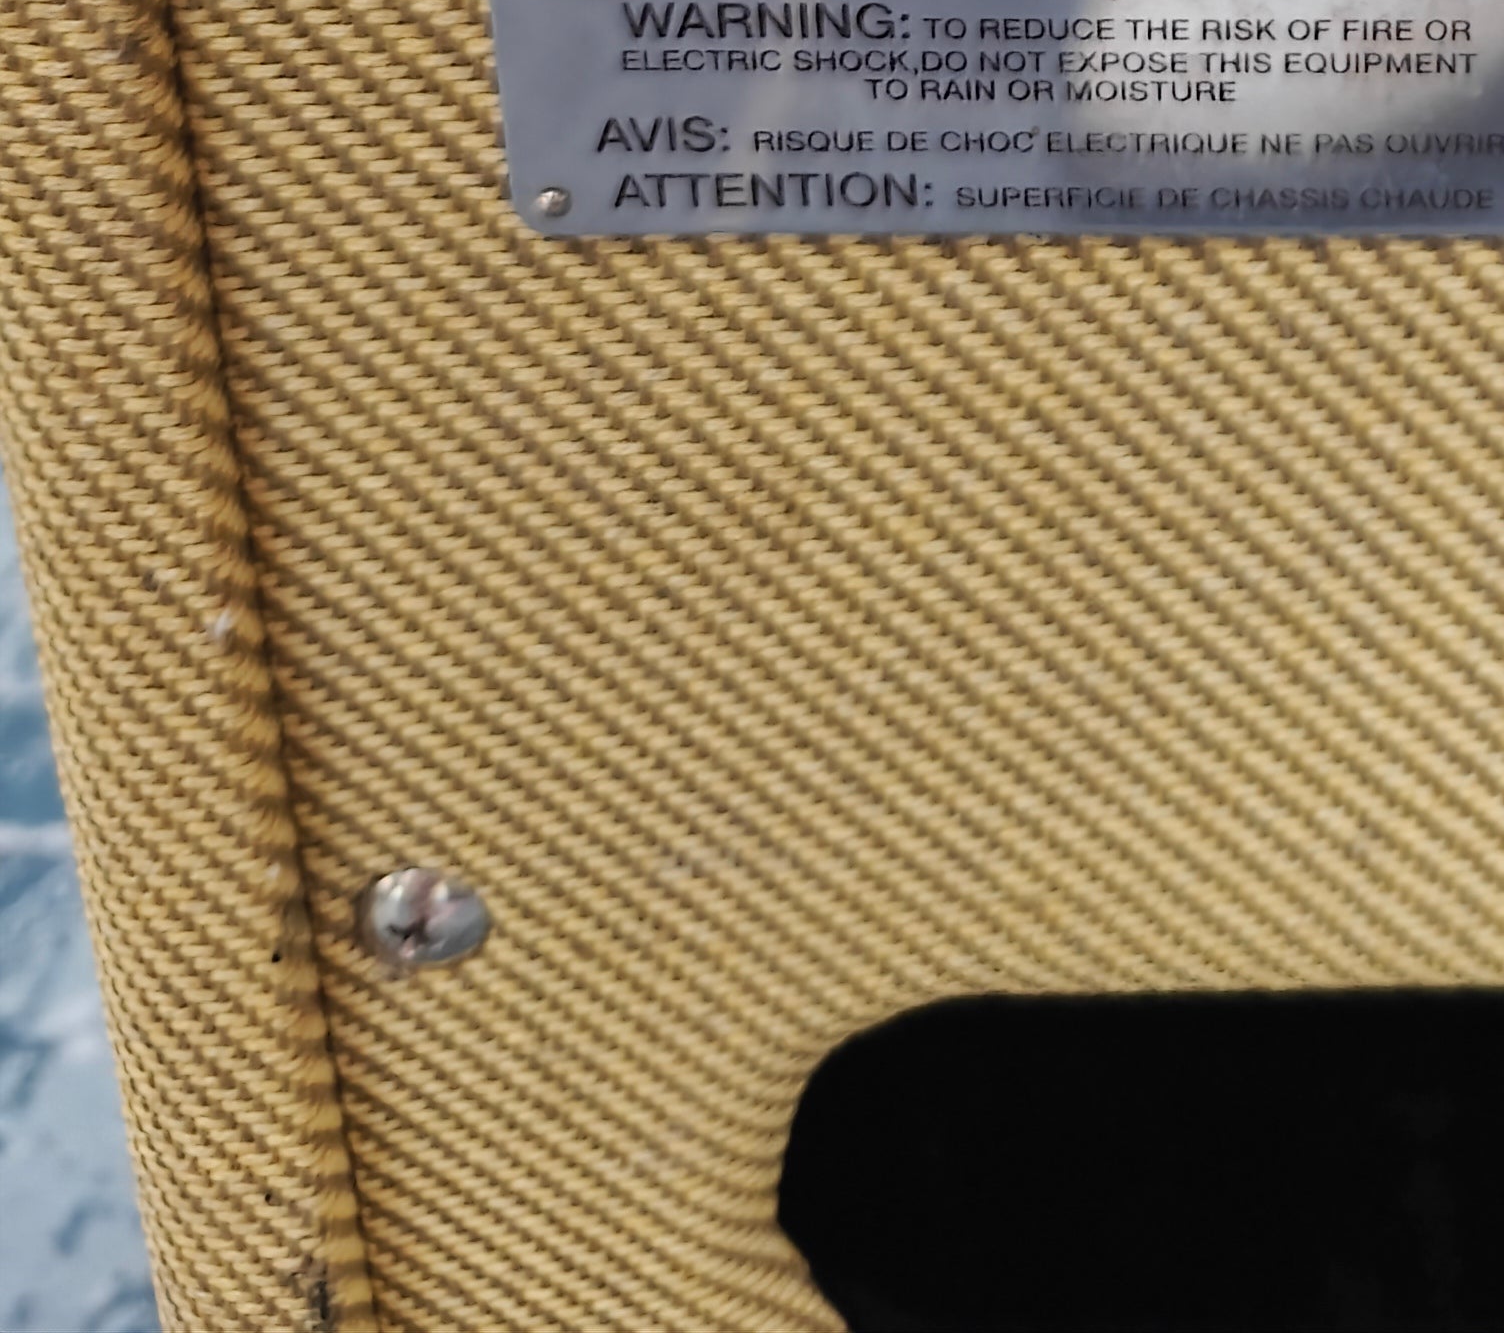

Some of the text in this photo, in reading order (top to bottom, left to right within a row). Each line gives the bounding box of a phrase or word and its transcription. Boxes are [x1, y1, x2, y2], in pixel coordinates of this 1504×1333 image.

[622, 2, 1471, 42] WARNING: TO REDUCE THE RISK OF FIRE OR
[622, 49, 782, 72] ELECTRIC
[979, 50, 1046, 73] NOT
[1059, 51, 1189, 74] EXPOSE
[1199, 52, 1272, 74] THIS
[1284, 52, 1478, 75] EQUIPMENT
[866, 79, 1236, 103] TO RAIN OR MOISTURE
[597, 116, 731, 154] AVIS:
[753, 131, 875, 153] RISQUE
[887, 131, 929, 153] DE
[1046, 132, 1248, 155] ELECTRIQUE
[1260, 133, 1302, 155] NE
[1315, 133, 1374, 155] PAS
[613, 172, 1494, 209] ATTENTION: SUPERFICIE DE CHASSIS CHAUDE
